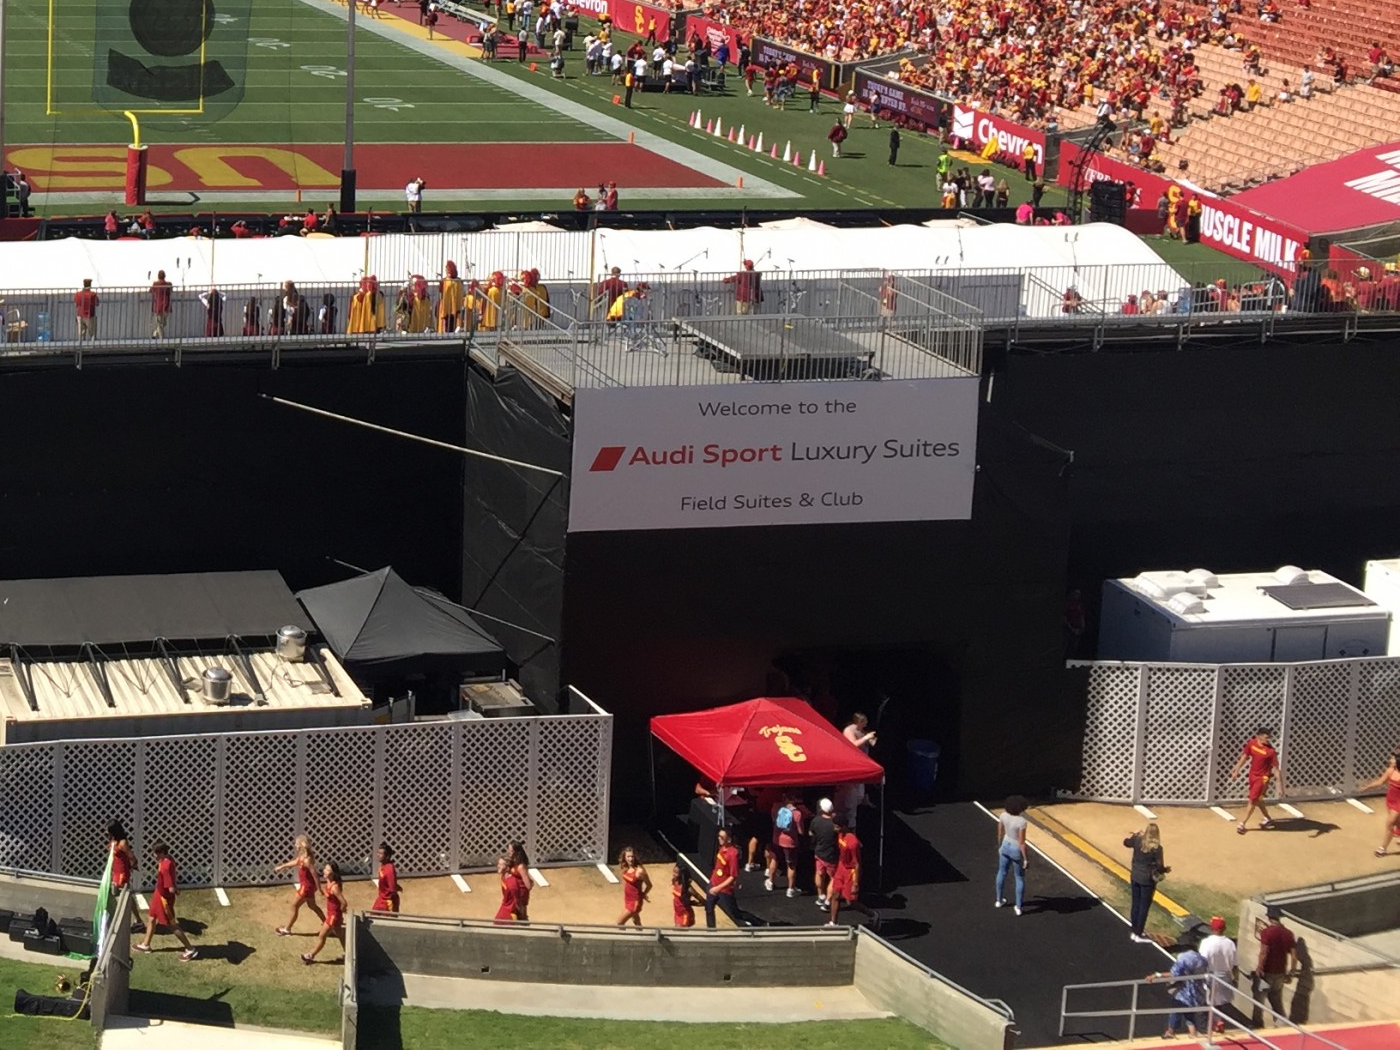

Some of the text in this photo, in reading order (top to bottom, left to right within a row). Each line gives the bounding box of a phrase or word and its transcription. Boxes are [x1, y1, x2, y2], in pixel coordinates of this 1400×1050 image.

[1254, 226, 1298, 273] MILK
[699, 399, 857, 416] Welcome to the
[628, 439, 960, 468] Audi Sport Luxury Suites
[681, 491, 863, 511] Field Suites & Club
[758, 724, 802, 738] Trojans
[774, 735, 807, 762] SC
